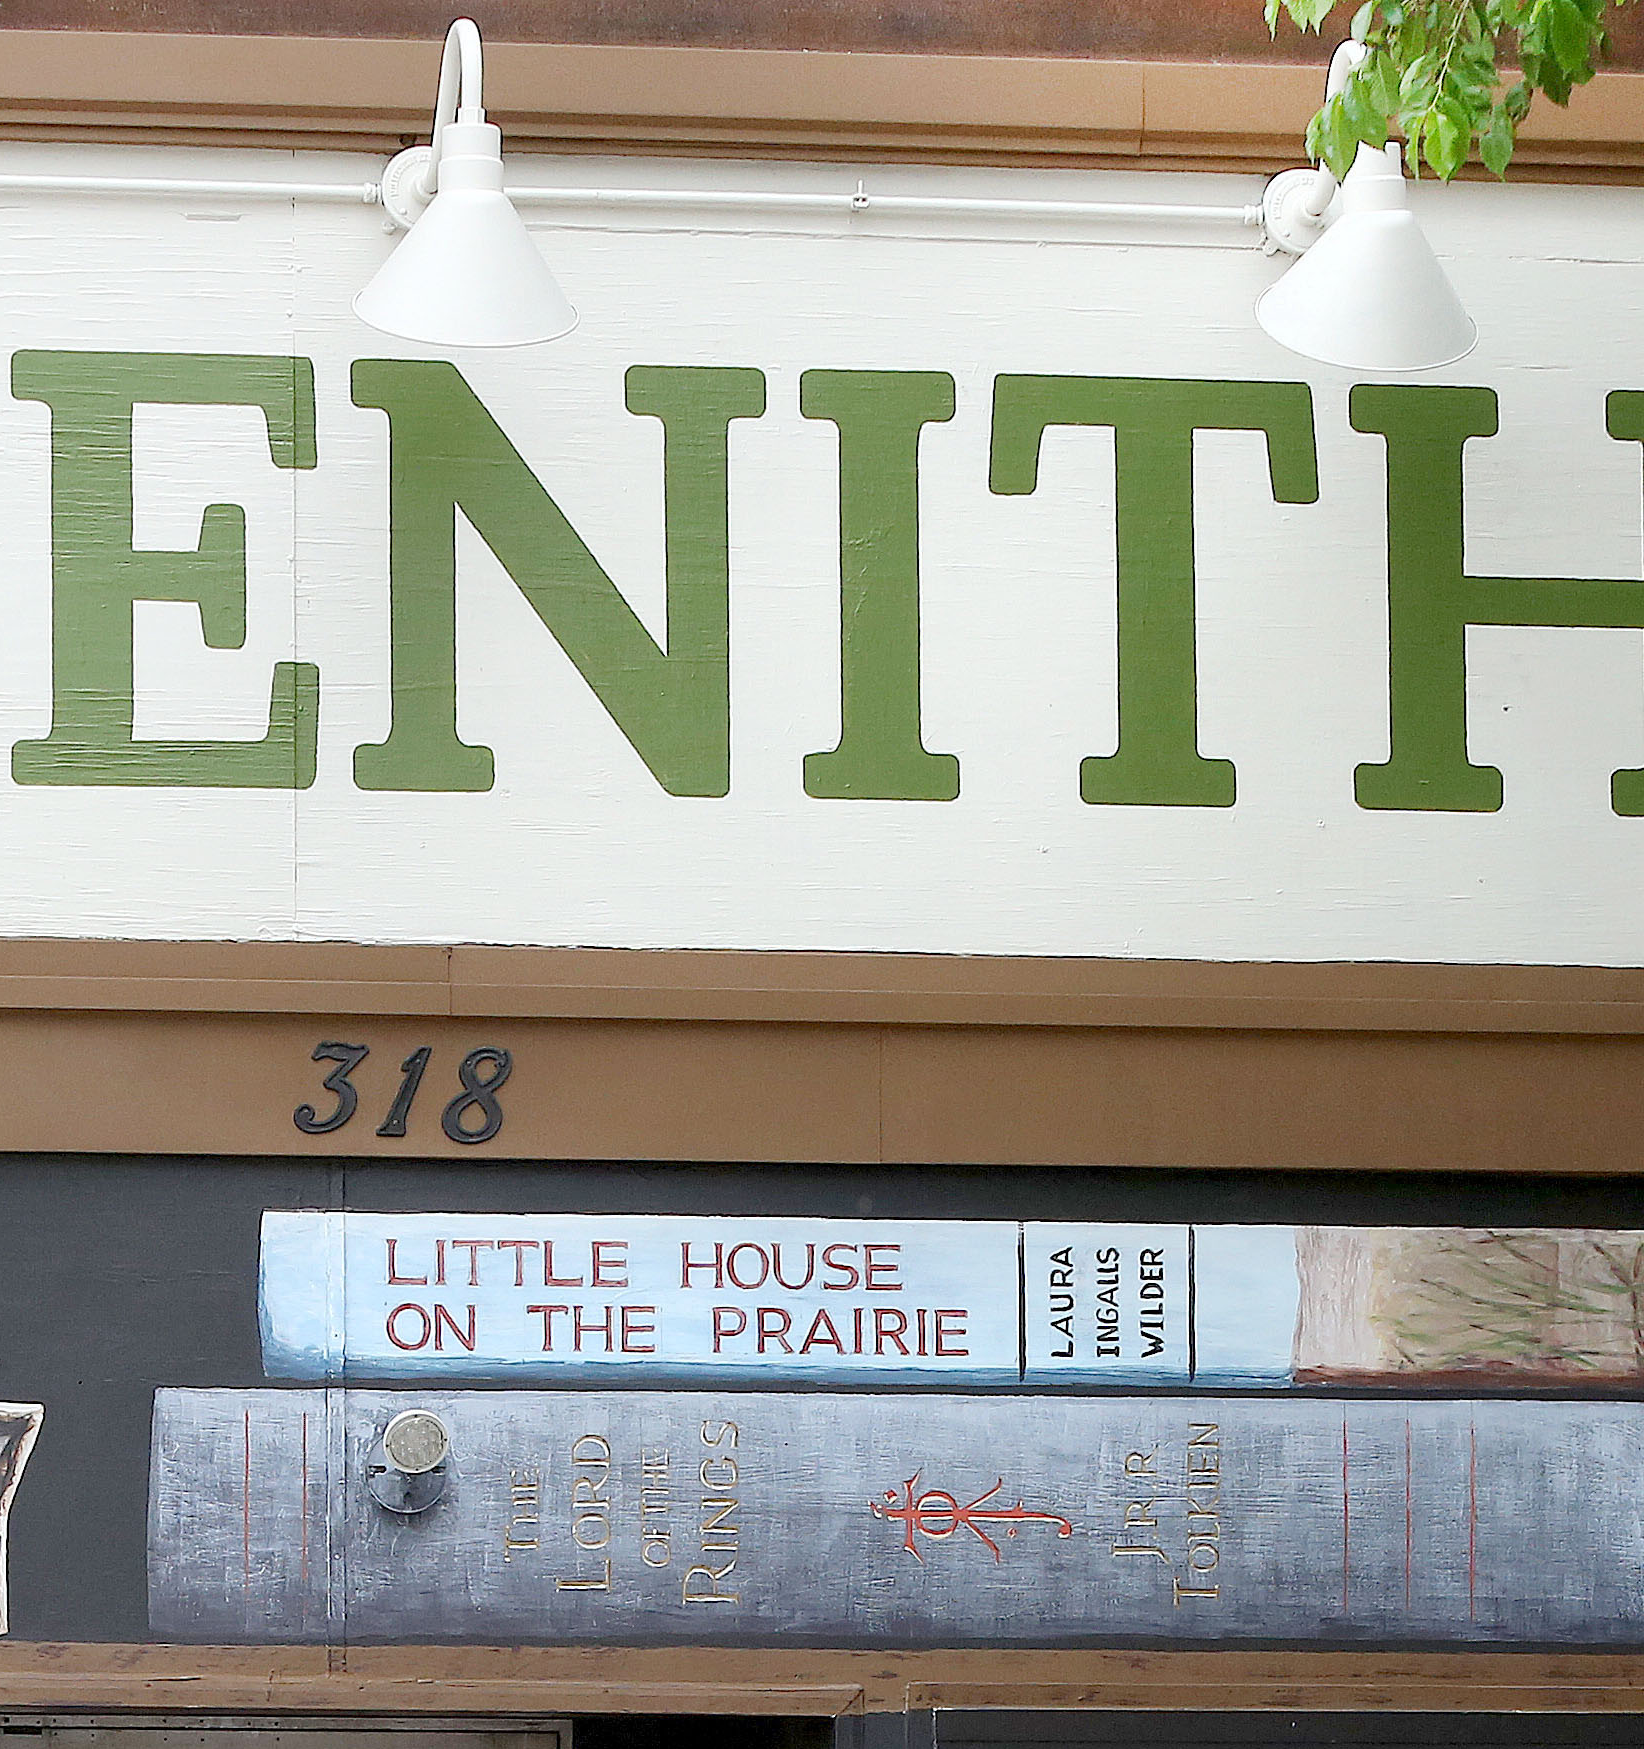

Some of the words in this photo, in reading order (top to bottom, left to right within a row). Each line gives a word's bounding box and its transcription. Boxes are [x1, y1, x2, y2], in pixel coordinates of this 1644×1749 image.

[293, 1040, 516, 1147] 318
[385, 1238, 629, 1288] LITTLE
[680, 1241, 903, 1292] HOUSE
[1050, 1246, 1074, 1358] LAURA
[1096, 1246, 1121, 1358] INGALLS
[1141, 1247, 1165, 1359] WILDER
[386, 1303, 477, 1351] ON
[527, 1305, 656, 1353] THE
[712, 1306, 969, 1357] PRAIRIE
[503, 1467, 541, 1563] THE
[556, 1434, 613, 1593] LORD
[642, 1447, 671, 1518] THE
[683, 1420, 740, 1605] RINGS
[1173, 1421, 1220, 1605] TOLKIEN
[642, 1526, 671, 1568] OF
